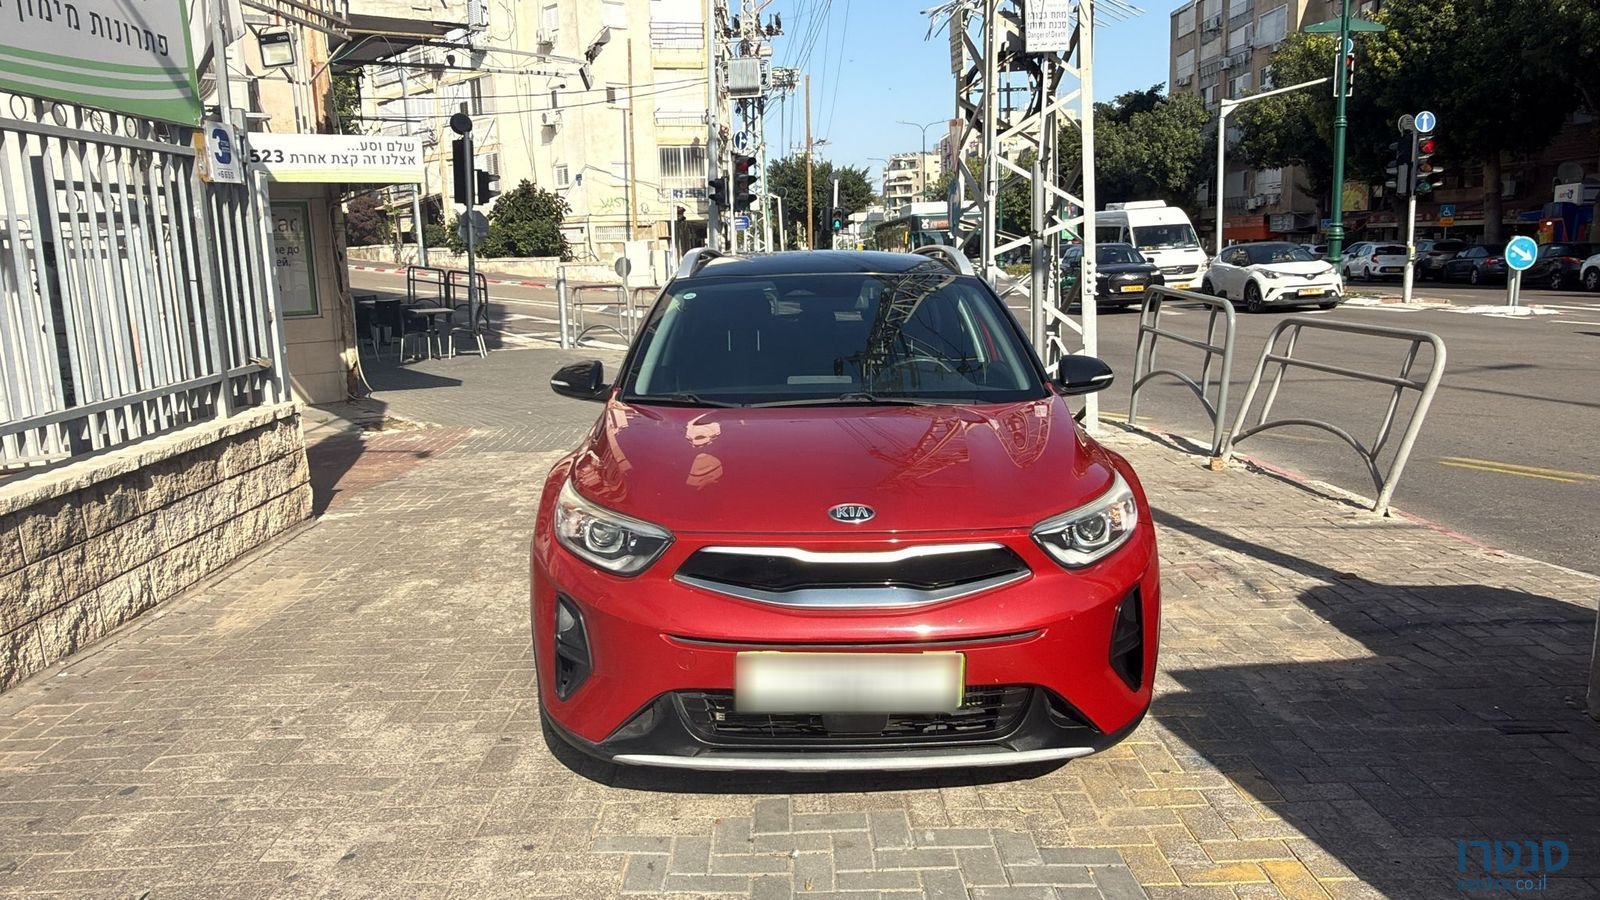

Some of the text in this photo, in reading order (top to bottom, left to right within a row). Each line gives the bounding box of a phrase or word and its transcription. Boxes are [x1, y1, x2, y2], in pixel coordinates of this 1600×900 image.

[89, 11, 169, 57] פתרונות
[386, 140, 415, 152] שלם
[289, 153, 327, 164] אחרת
[331, 154, 359, 167] קצת
[363, 154, 376, 164] זה
[381, 153, 416, 165] אצלנו
[836, 506, 869, 518] KIA
